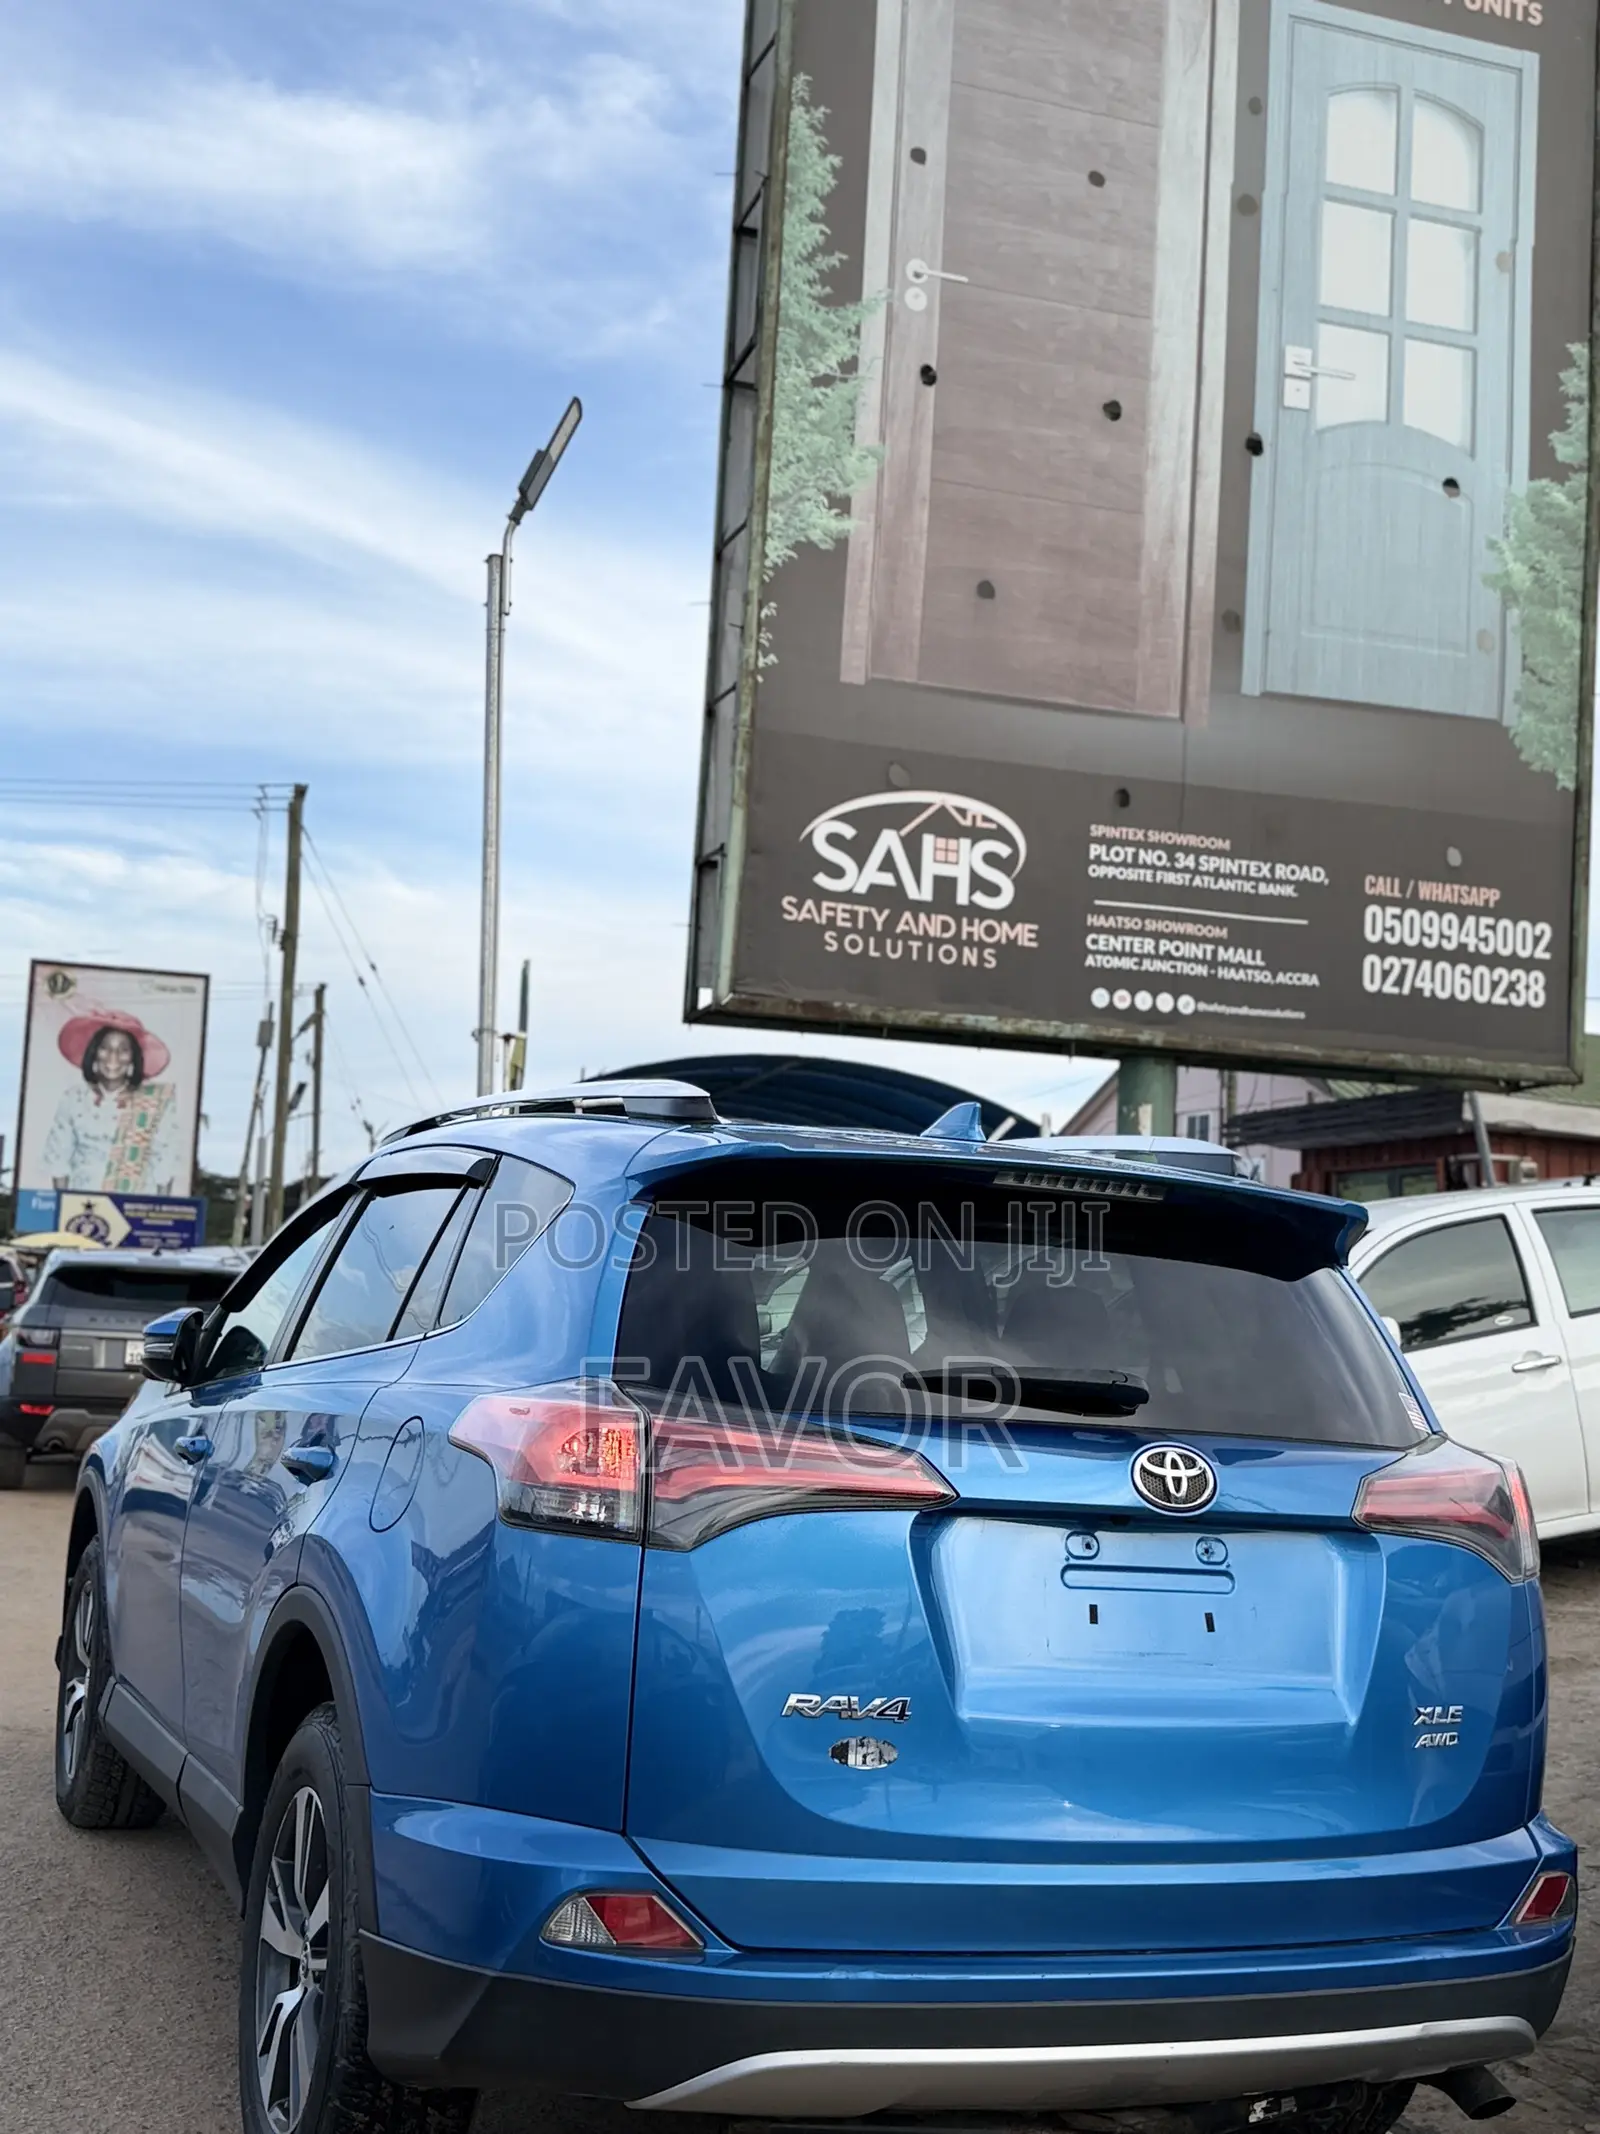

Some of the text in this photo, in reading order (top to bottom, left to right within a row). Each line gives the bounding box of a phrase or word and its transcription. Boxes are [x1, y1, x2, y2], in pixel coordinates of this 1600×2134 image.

[1089, 823, 1231, 852] SPINTEX SHOWROOM
[812, 819, 1014, 910] SAHS
[1087, 864, 1155, 883] OPPOSITE
[1155, 870, 1192, 887] FIRST
[1192, 874, 1256, 894] ATLANTIC
[1088, 843, 1329, 886] PLOT NO. 34 SPINTEX ROAD,
[1364, 874, 1500, 908] CALL / WHATSAPP
[781, 895, 1039, 948] SAFETY AND HOME
[1086, 913, 1228, 939] HAATSO SHOWROOM
[1363, 904, 1552, 960] 0509945002
[824, 930, 997, 969] SOLUTIONS
[1085, 933, 1266, 967] CENTER POINT MALL
[1084, 953, 1140, 971] ATOMIC
[1140, 958, 1208, 977] JUNCTION
[1275, 971, 1320, 987] ACCRA
[1362, 954, 1546, 1008] 0274060238
[781, 1692, 913, 1723] RAV4
[1413, 1705, 1464, 1725] XLE
[1414, 1731, 1459, 1749] AWD
